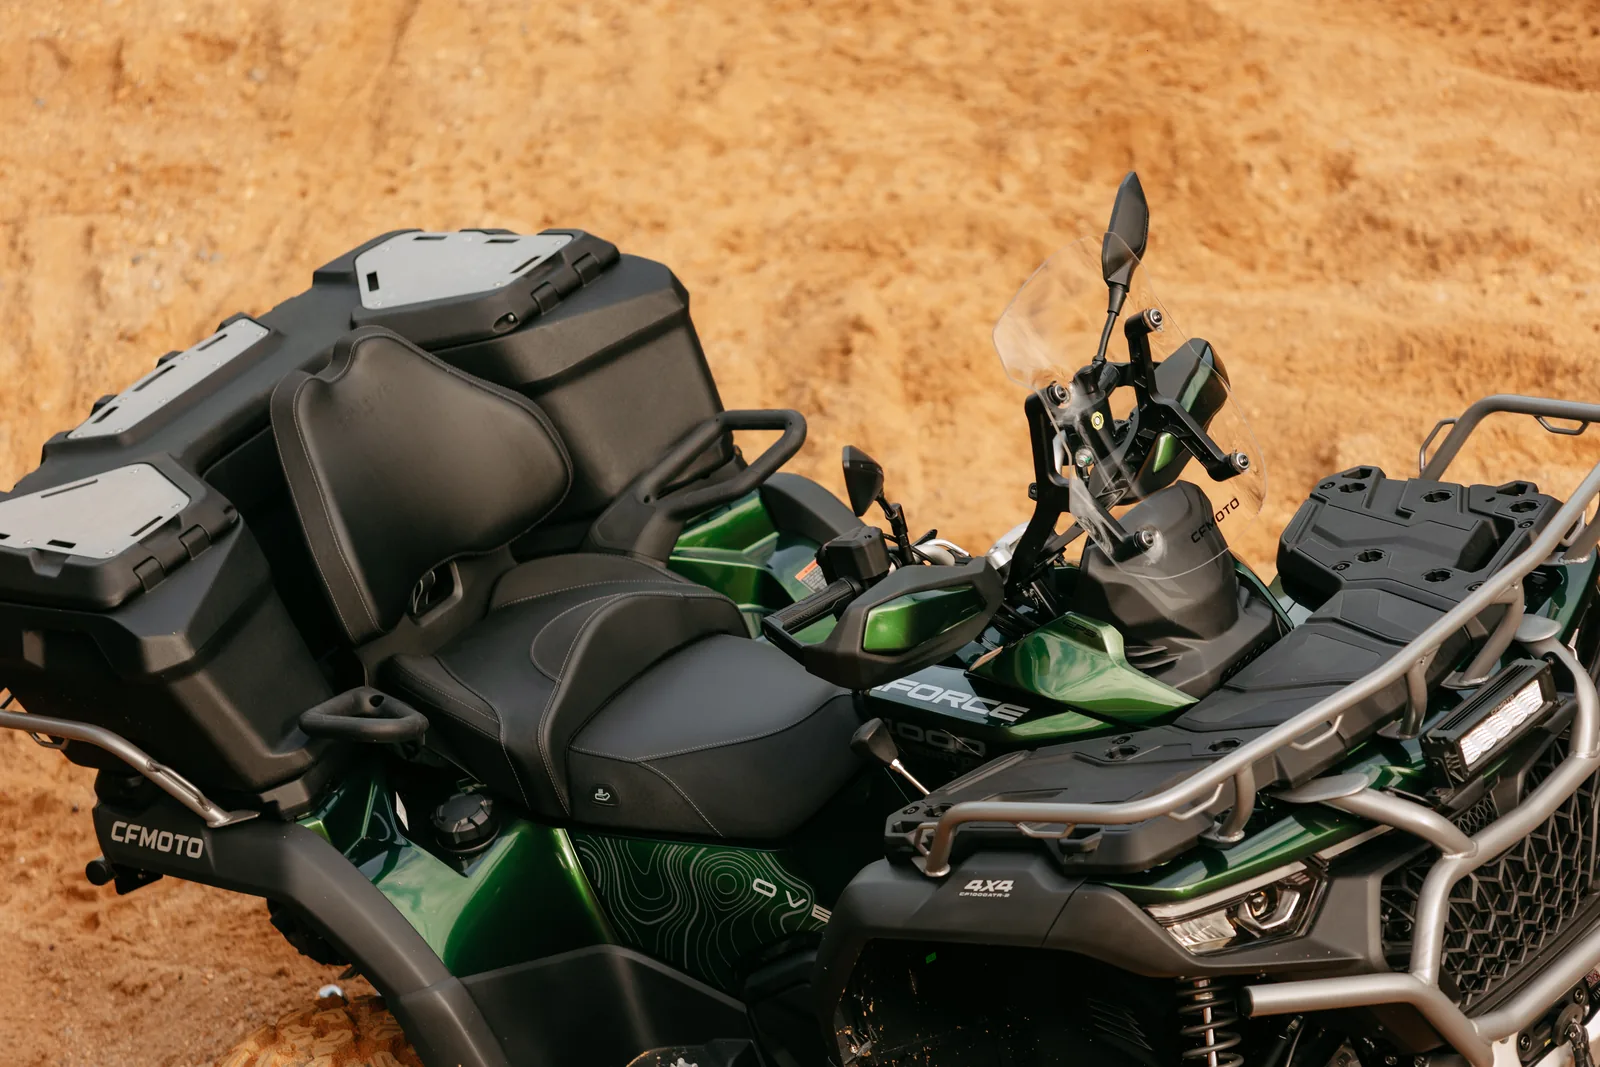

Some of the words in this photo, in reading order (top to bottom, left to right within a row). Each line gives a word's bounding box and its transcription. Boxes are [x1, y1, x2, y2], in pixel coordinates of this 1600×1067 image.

[1191, 498, 1240, 543] CFMOTO
[872, 678, 1031, 722] FORCE
[111, 821, 204, 859] CFMOTO
[964, 879, 1014, 893] 4X4
